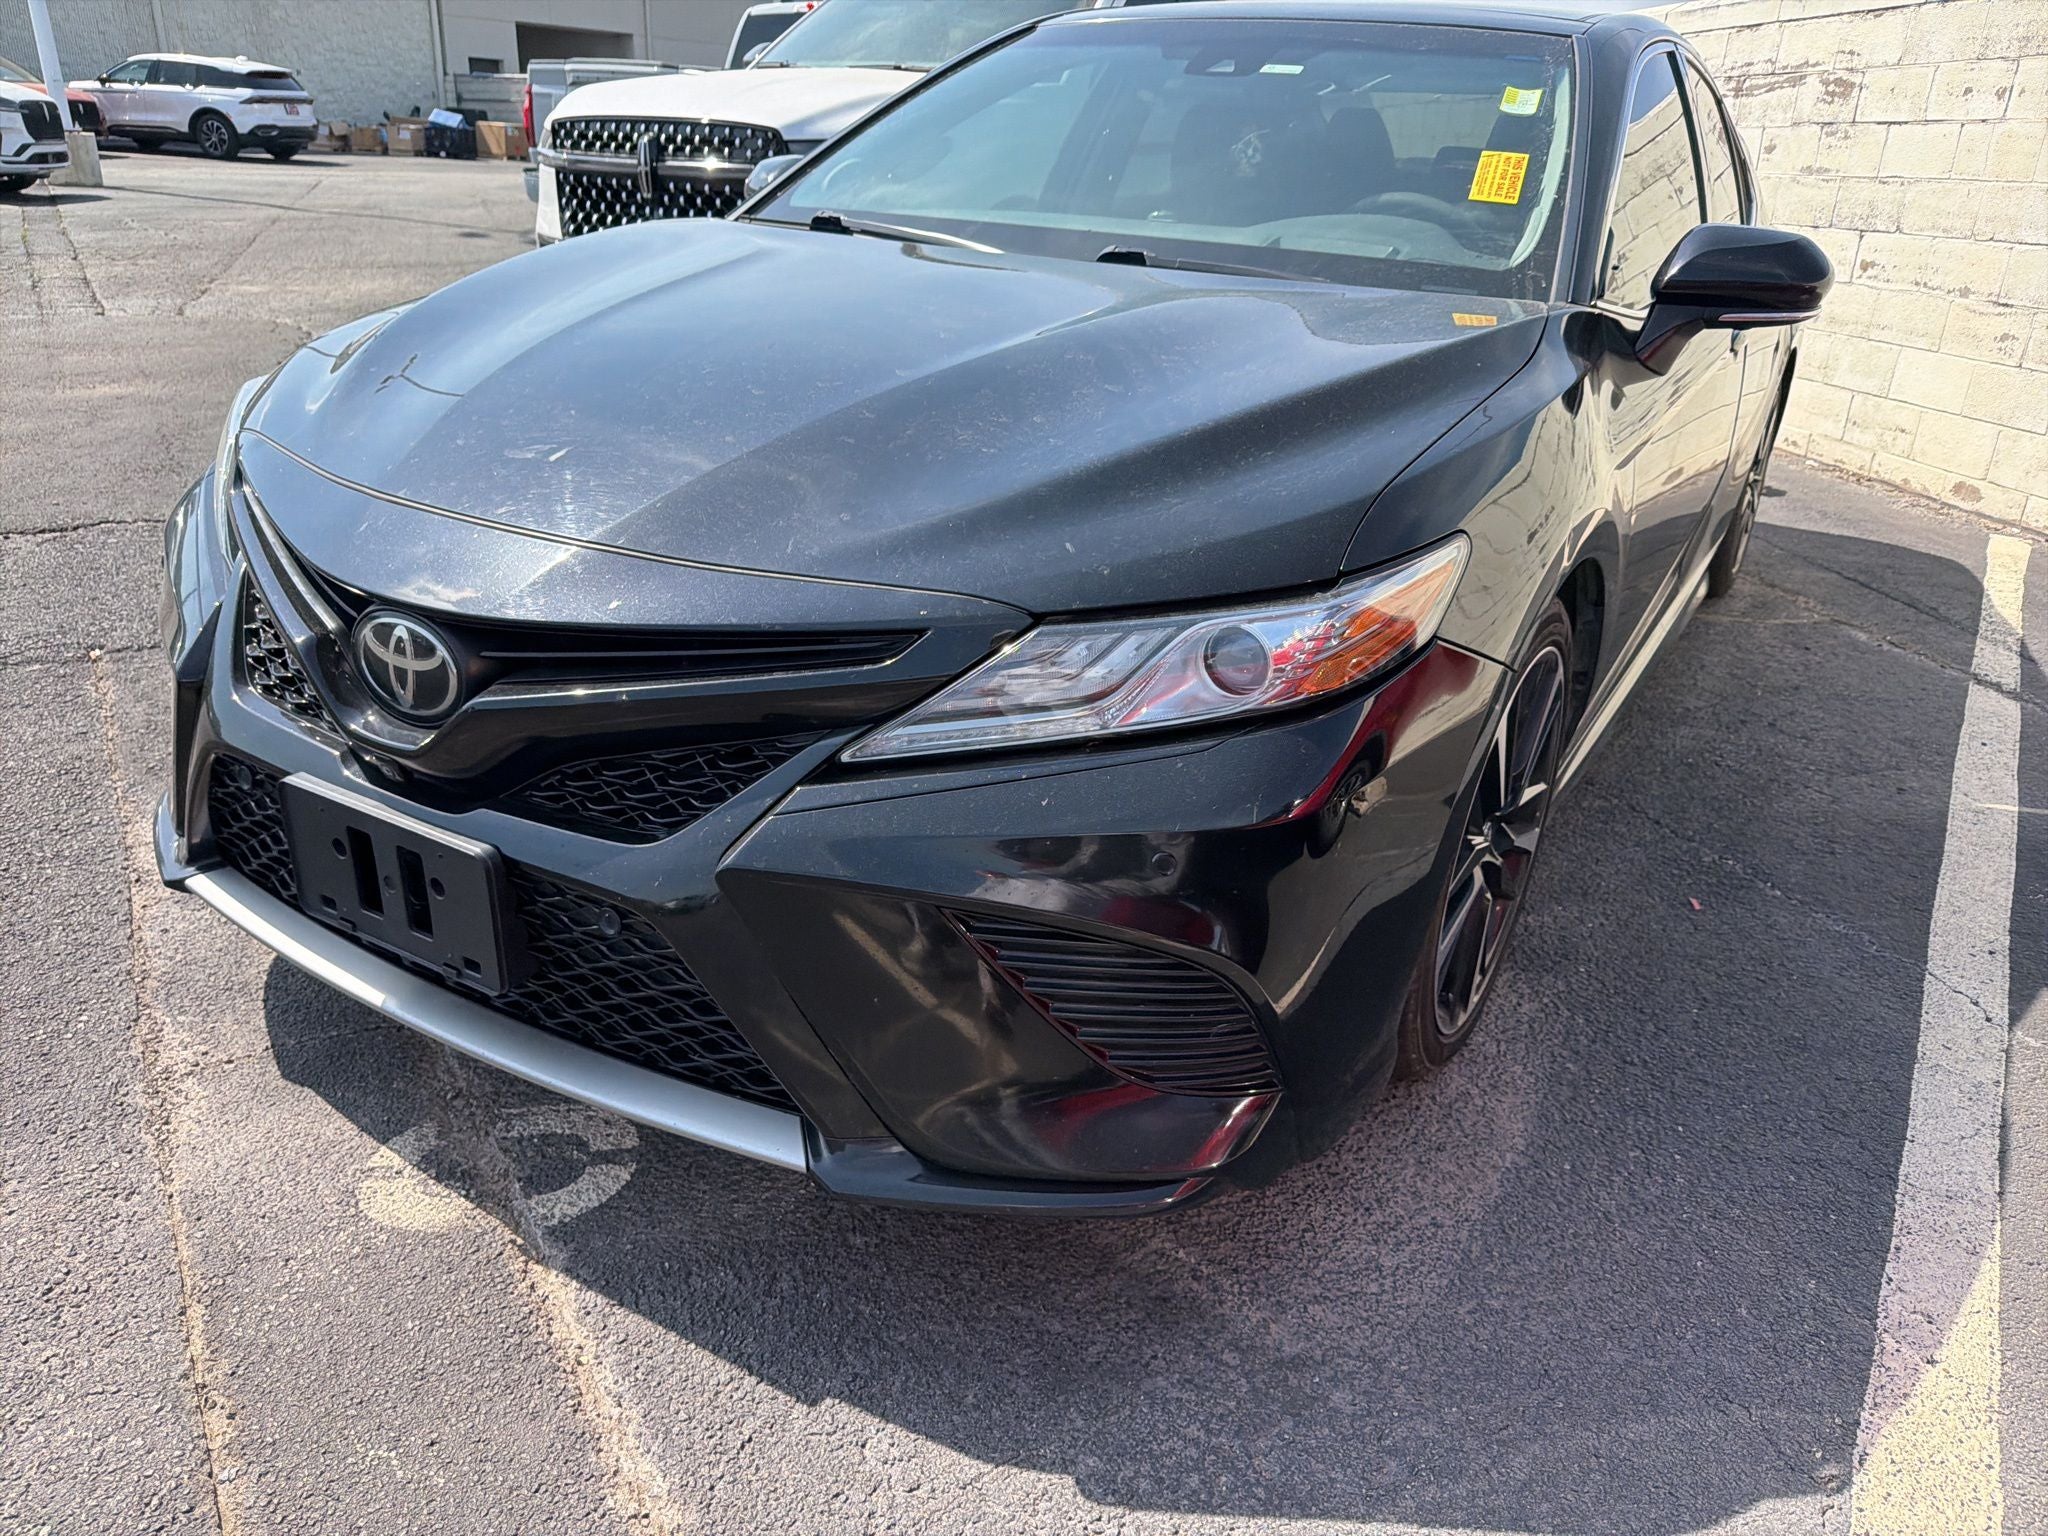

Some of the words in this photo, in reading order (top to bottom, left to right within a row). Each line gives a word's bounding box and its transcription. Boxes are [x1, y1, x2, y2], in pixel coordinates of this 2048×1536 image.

[1502, 156, 1512, 168] NOT
[1512, 156, 1525, 171] THIS
[1499, 168, 1509, 181] FOR
[1494, 182, 1505, 197] SALE
[1504, 172, 1521, 201] VEHICLE
